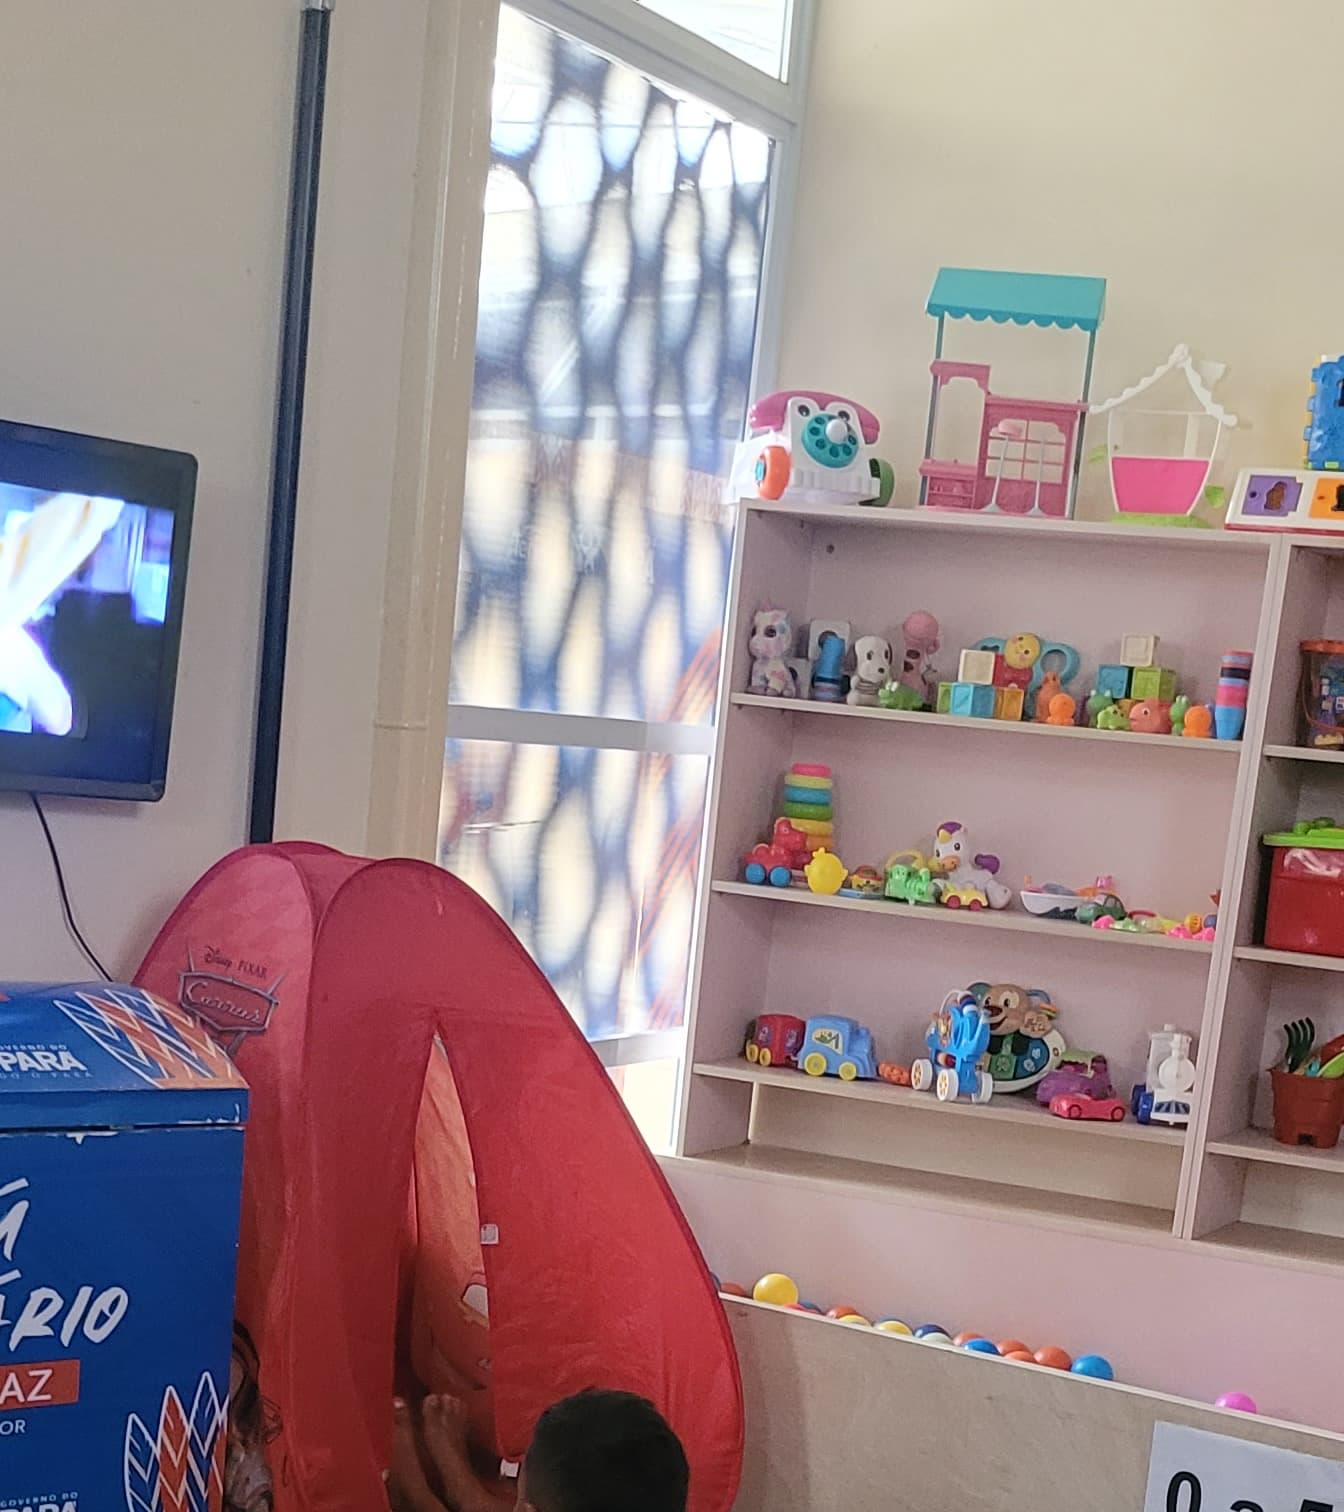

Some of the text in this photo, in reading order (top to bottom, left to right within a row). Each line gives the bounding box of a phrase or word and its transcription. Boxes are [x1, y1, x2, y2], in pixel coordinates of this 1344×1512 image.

[204, 945, 267, 979] Disney PIXAR
[0, 1494, 57, 1508] GOVERNO
